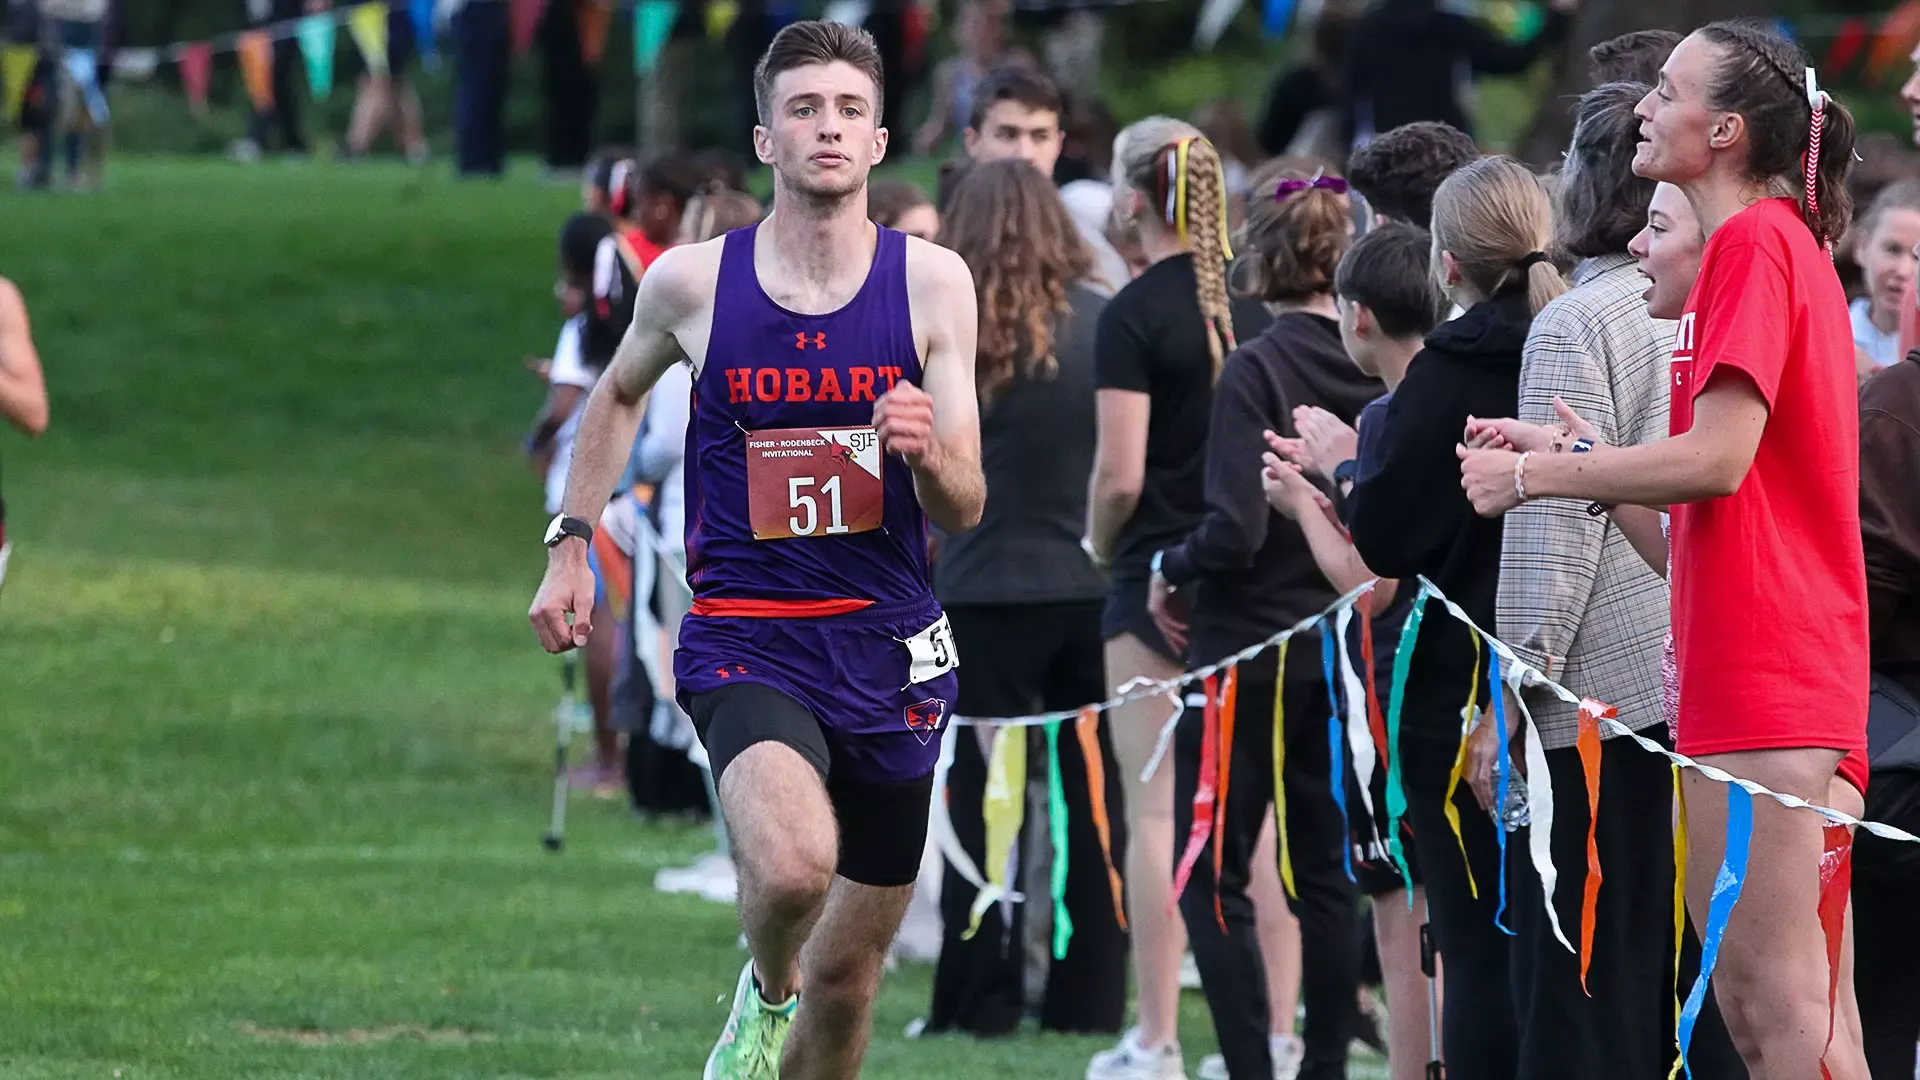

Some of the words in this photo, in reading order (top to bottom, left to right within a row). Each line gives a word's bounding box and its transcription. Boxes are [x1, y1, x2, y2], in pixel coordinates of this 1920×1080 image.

[725, 366, 902, 404] HOBART
[749, 440, 776, 449] FISHER
[780, 438, 826, 448] RODENBECK
[849, 432, 878, 452] SJF
[762, 449, 813, 458] INVITATIONAL
[788, 475, 849, 536] 51
